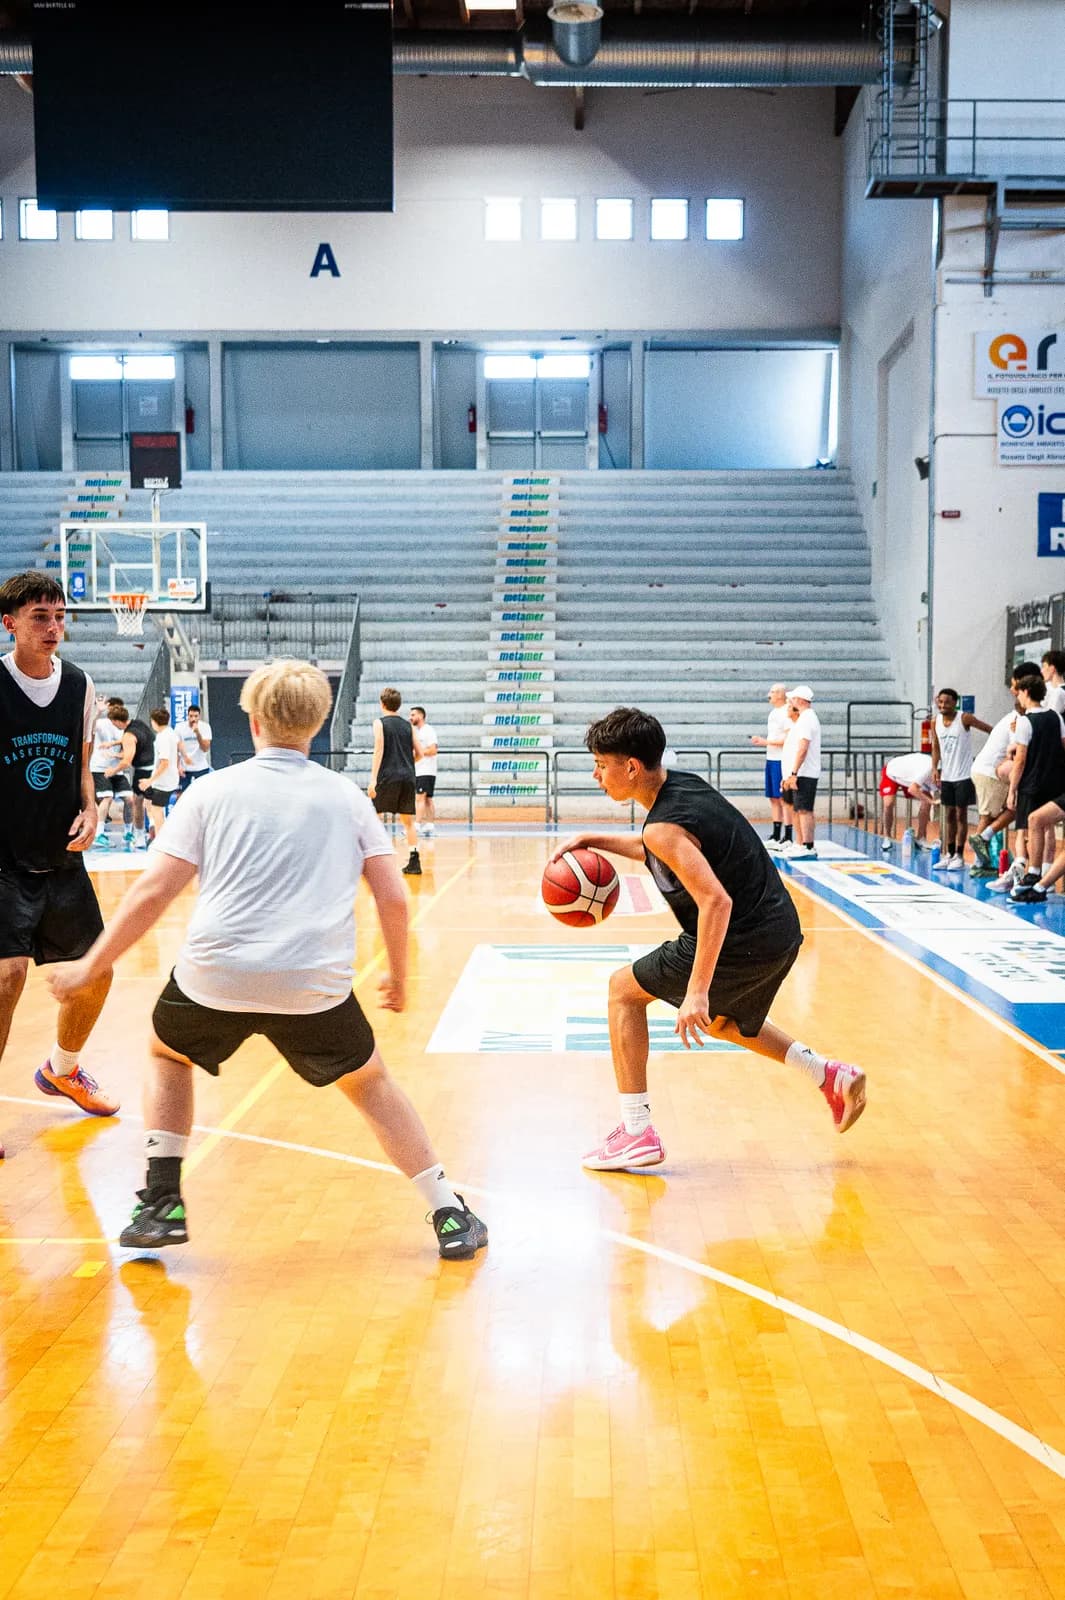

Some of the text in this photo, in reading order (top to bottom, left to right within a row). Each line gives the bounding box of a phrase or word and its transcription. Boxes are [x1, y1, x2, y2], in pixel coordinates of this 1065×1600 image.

[310, 243, 341, 278] A
[507, 542, 547, 550] metamer
[506, 559, 546, 567] metamer
[504, 576, 546, 584] metamer
[503, 593, 545, 602] metamer
[502, 612, 544, 621] metamer
[500, 632, 543, 641] metamer
[499, 652, 543, 662] metamer
[498, 671, 542, 681] metamer
[496, 693, 541, 702] metamer
[494, 715, 541, 725] metamer
[11, 732, 70, 748] TRANSFORMING
[493, 736, 540, 747] metamer
[491, 761, 539, 771] metamer
